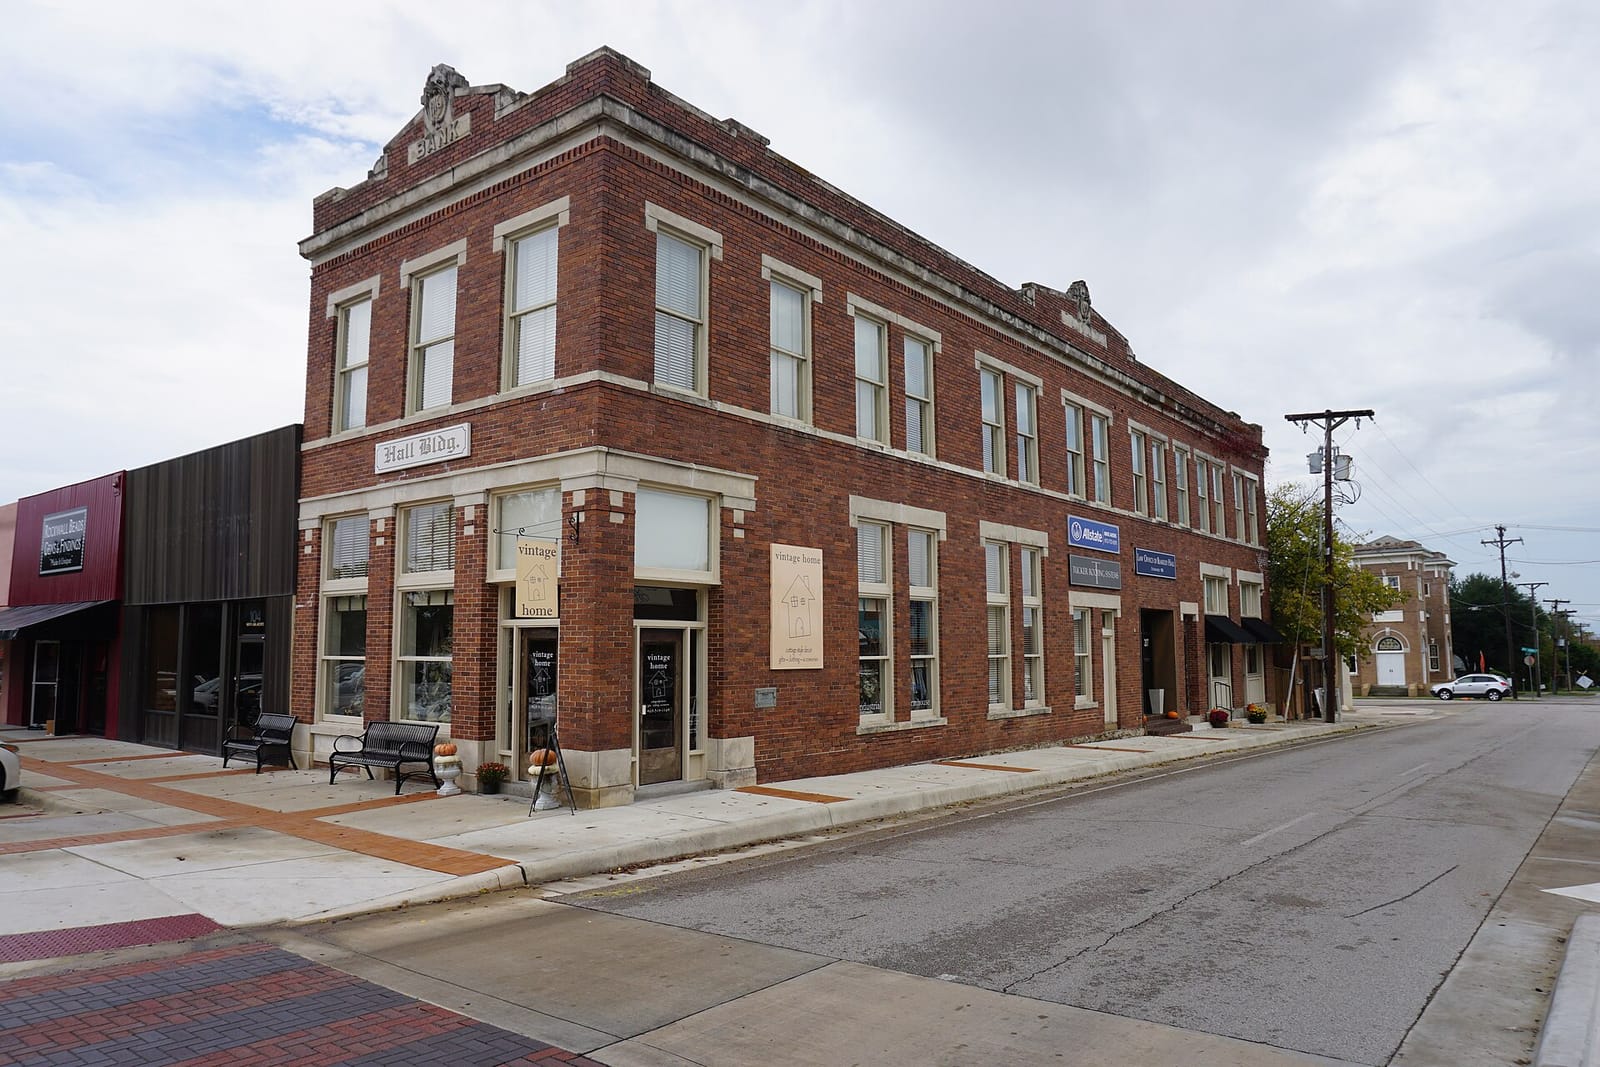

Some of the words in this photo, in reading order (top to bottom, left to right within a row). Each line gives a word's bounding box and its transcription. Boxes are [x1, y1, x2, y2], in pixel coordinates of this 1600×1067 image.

[416, 119, 460, 160] BANK
[383, 442, 415, 464] Hall
[419, 435, 460, 456] Bldg.
[518, 544, 557, 560] vintage
[775, 551, 801, 564] vintage
[802, 553, 822, 565] home
[522, 603, 553, 617] home
[532, 651, 554, 659] vintage
[647, 653, 671, 662] vintage
[534, 659, 551, 667] home
[649, 662, 668, 670] home
